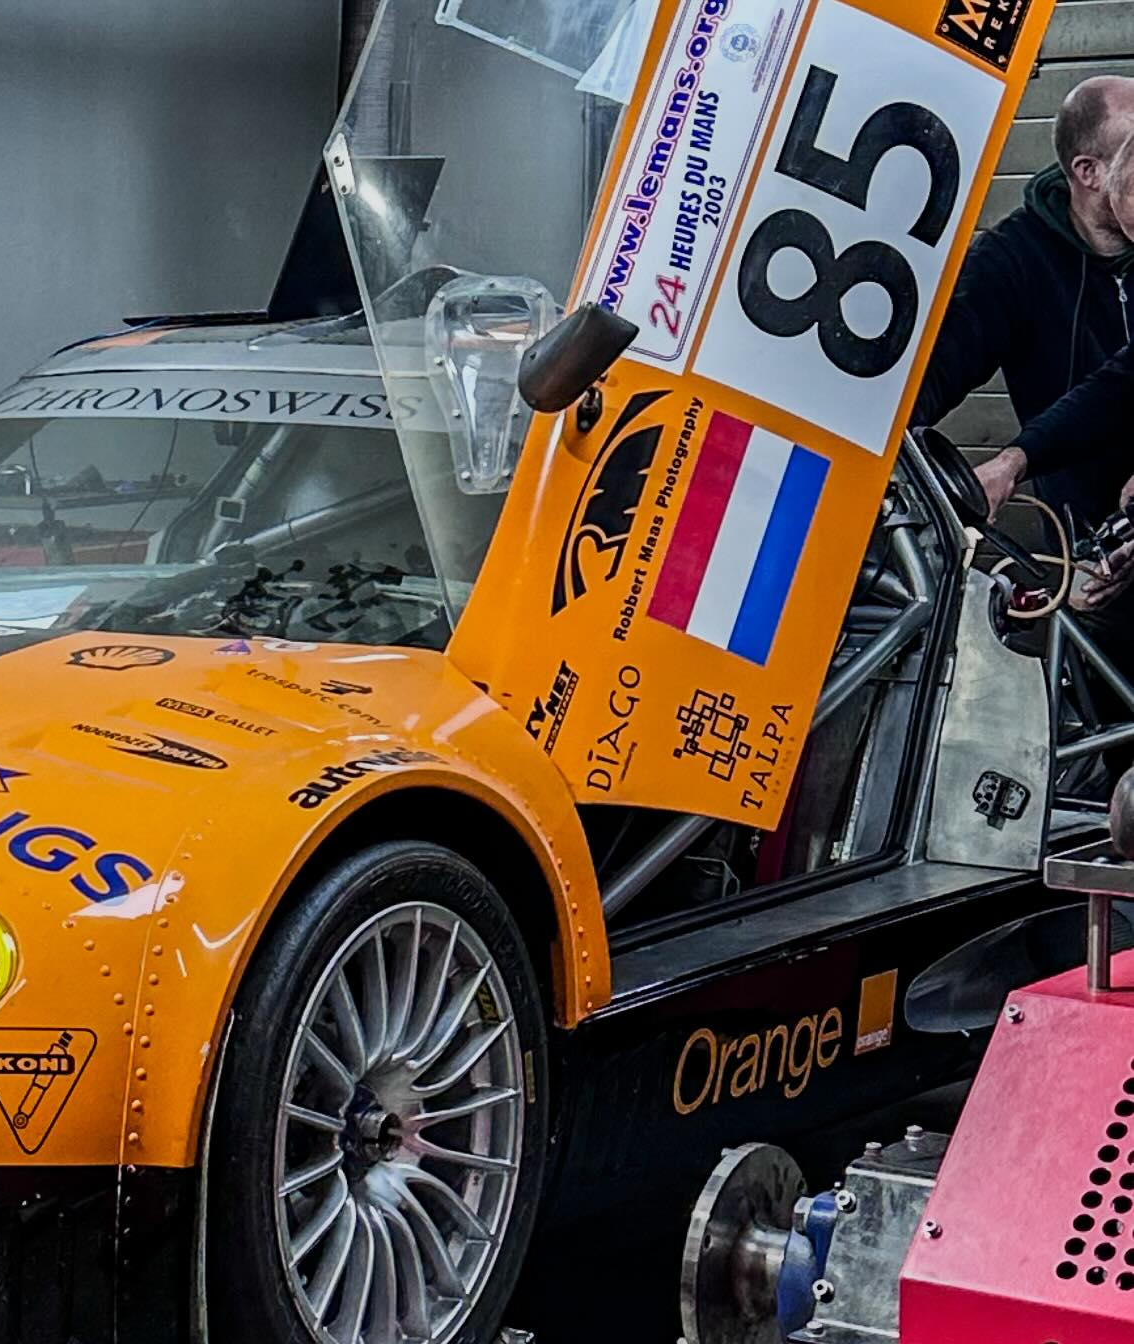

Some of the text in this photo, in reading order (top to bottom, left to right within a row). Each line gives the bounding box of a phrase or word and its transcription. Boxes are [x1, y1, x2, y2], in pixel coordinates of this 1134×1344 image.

[648, 90, 721, 340] 24 HEURES DU MANS
[702, 175, 727, 227] 2003
[737, 64, 961, 379] 85
[612, 396, 704, 642] Robbert Maas Photography
[213, 713, 280, 738] GALLET
[740, 704, 794, 810] TALPA
[673, 1006, 843, 1115] Orange
